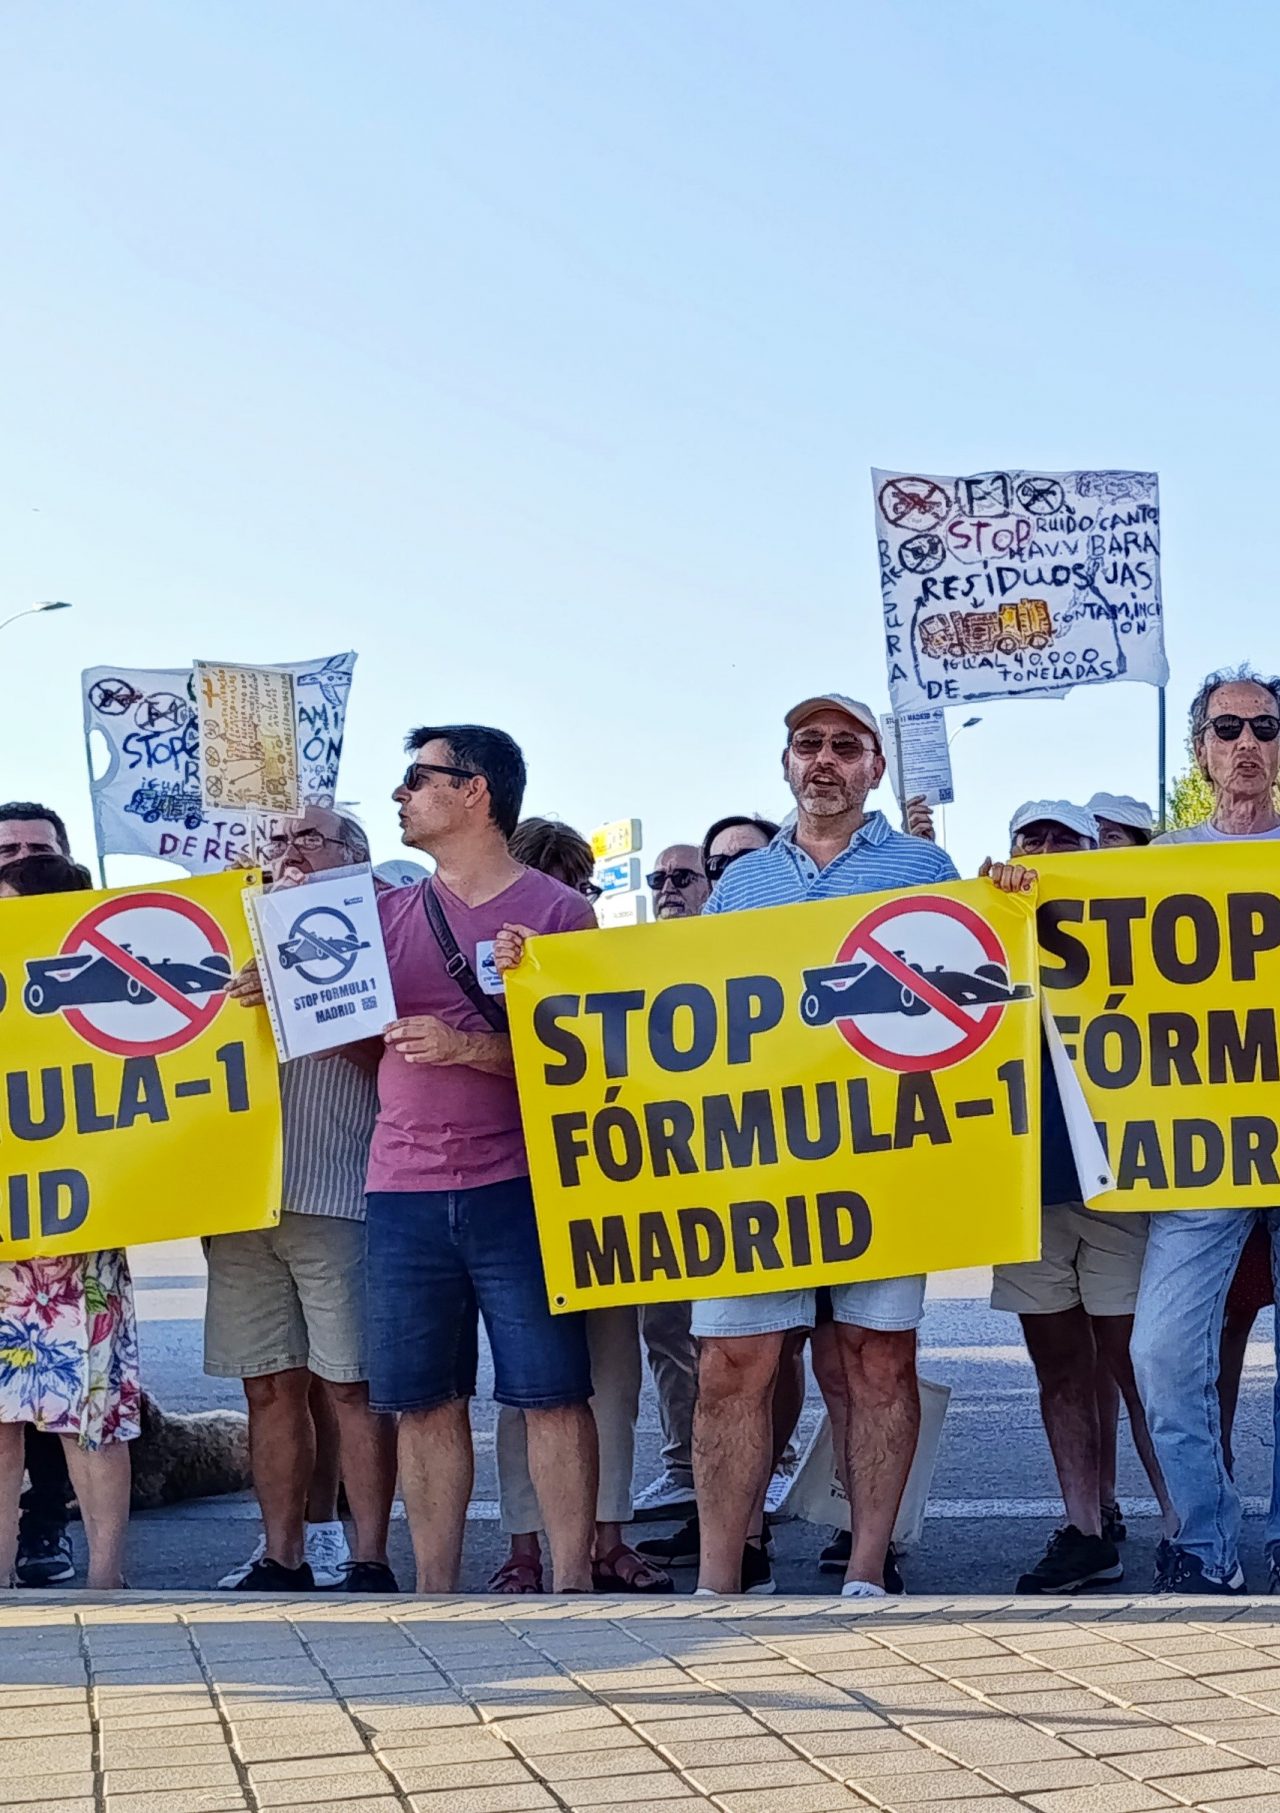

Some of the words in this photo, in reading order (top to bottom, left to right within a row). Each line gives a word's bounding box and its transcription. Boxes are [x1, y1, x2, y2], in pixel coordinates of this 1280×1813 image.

[948, 519, 1032, 556] STOP
[1036, 515, 1094, 534] RUIDO
[1091, 531, 1160, 559] BARA
[1104, 561, 1153, 591] JAS
[927, 679, 961, 700] DE
[293, 992, 319, 1012] STOP
[320, 979, 369, 1004] FORMULA
[368, 977, 377, 991] 1
[315, 1001, 357, 1024] MADRID
[533, 974, 785, 1087] STOP
[0, 1041, 250, 1142] ULA-1
[551, 1058, 1030, 1188] FÓRMULA-1
[0, 1168, 90, 1242] ID
[568, 1190, 873, 1290] MADRID
